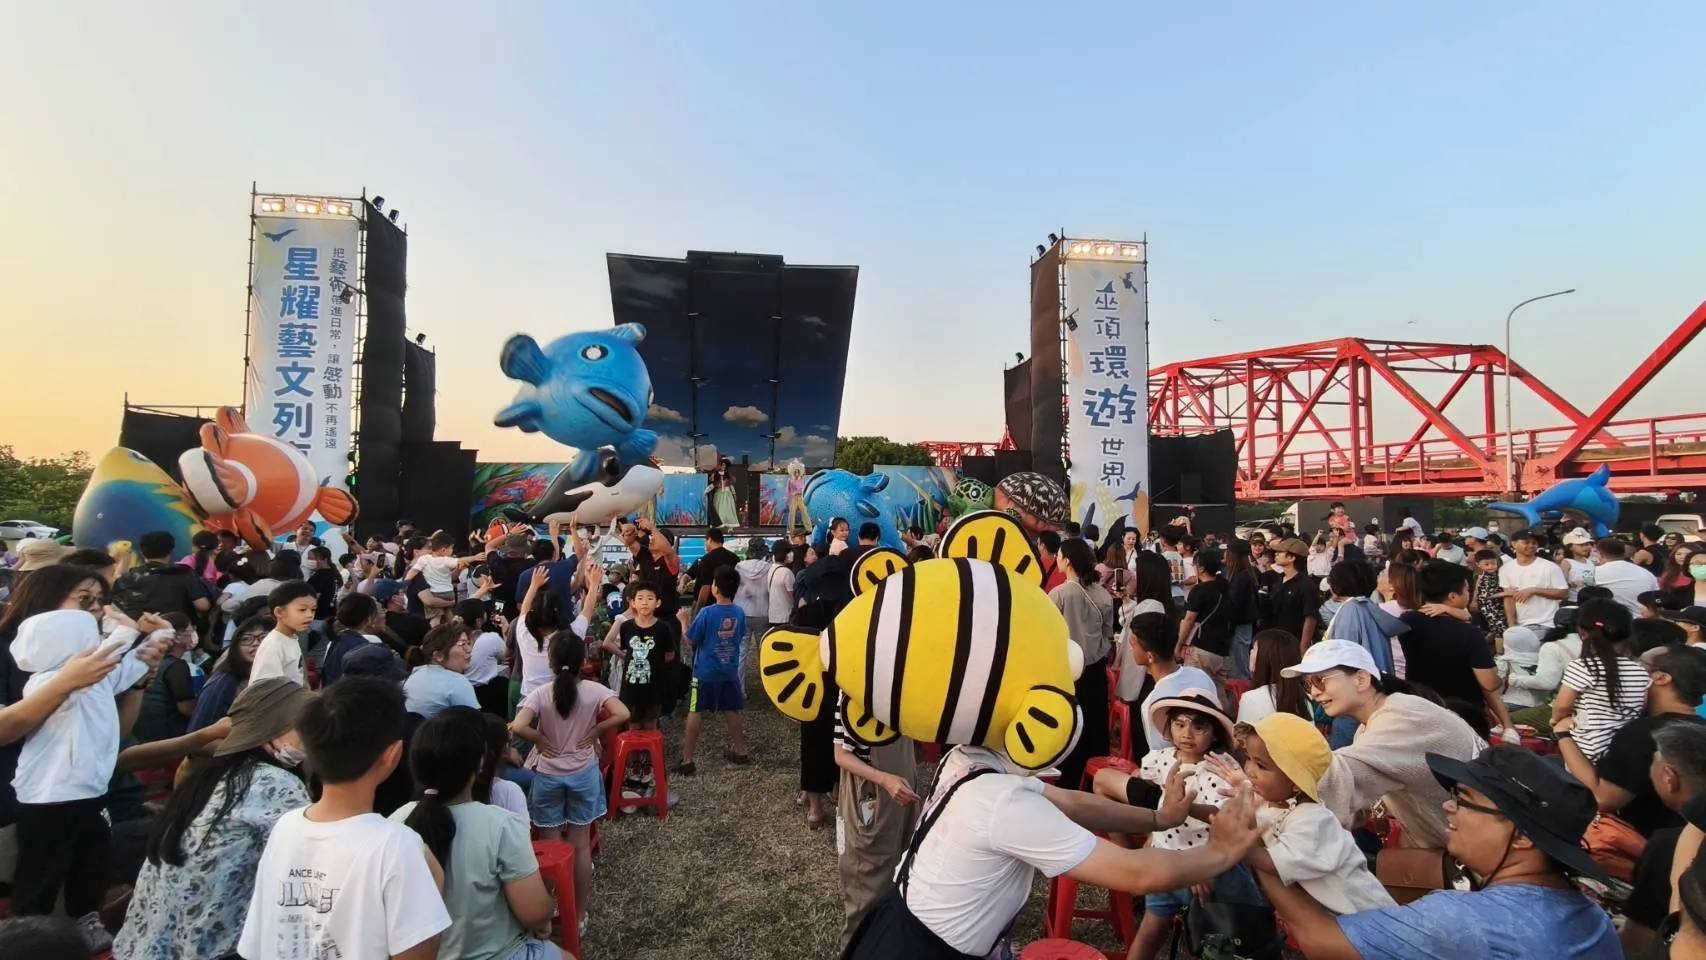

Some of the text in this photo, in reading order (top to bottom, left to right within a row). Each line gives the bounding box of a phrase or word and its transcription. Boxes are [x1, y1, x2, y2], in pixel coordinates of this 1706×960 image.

[272, 246, 321, 457] 星耀藝文列
[1083, 280, 1137, 486] 巫頂環遊世界
